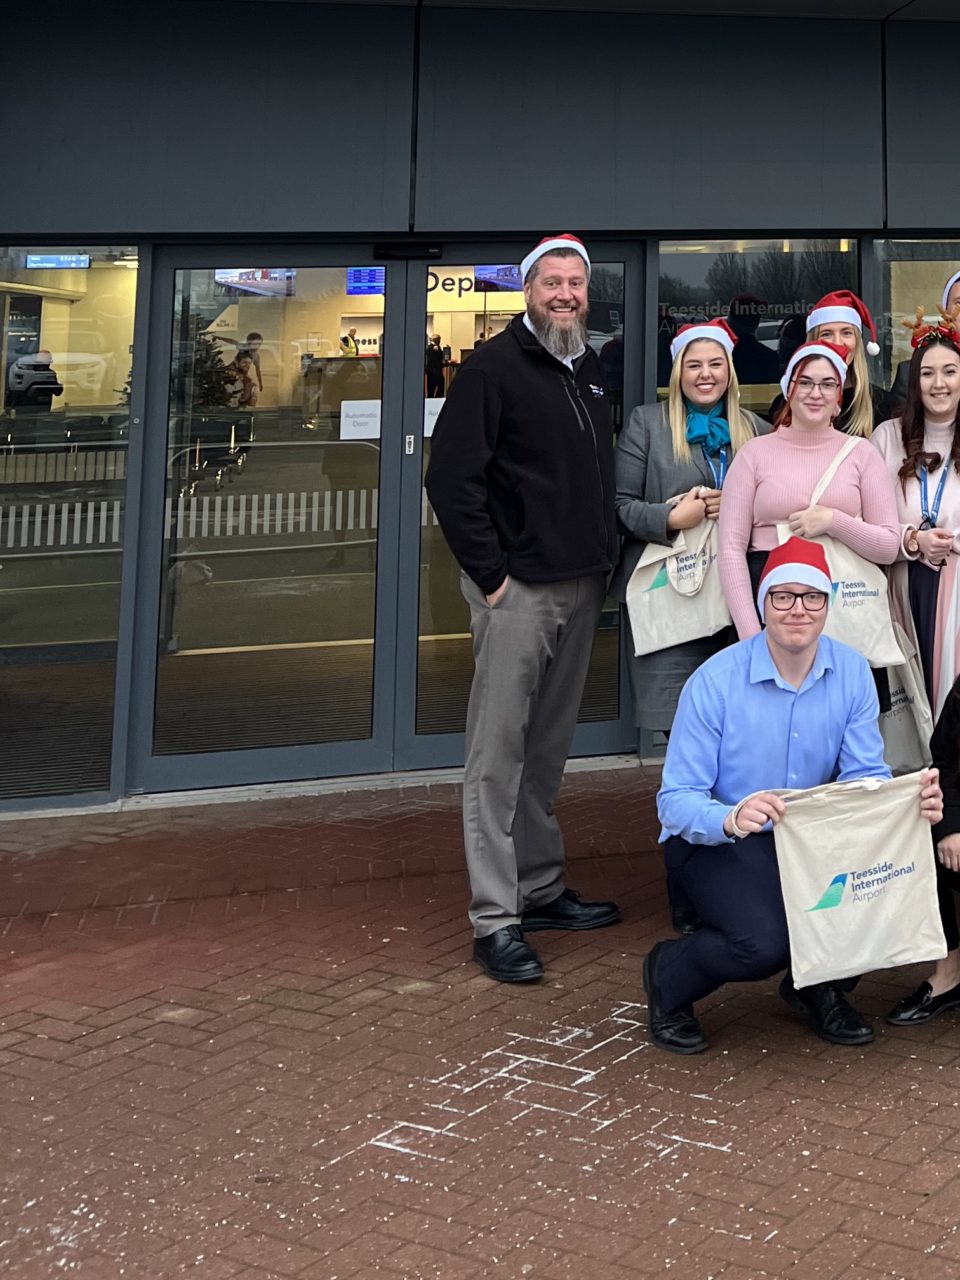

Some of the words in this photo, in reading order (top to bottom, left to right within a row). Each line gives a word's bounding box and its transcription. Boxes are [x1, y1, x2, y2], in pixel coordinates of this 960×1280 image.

[659, 300, 730, 317] Teesside
[850, 860, 894, 882] Teesside
[851, 862, 916, 893] International
[852, 886, 887, 904] Airport
